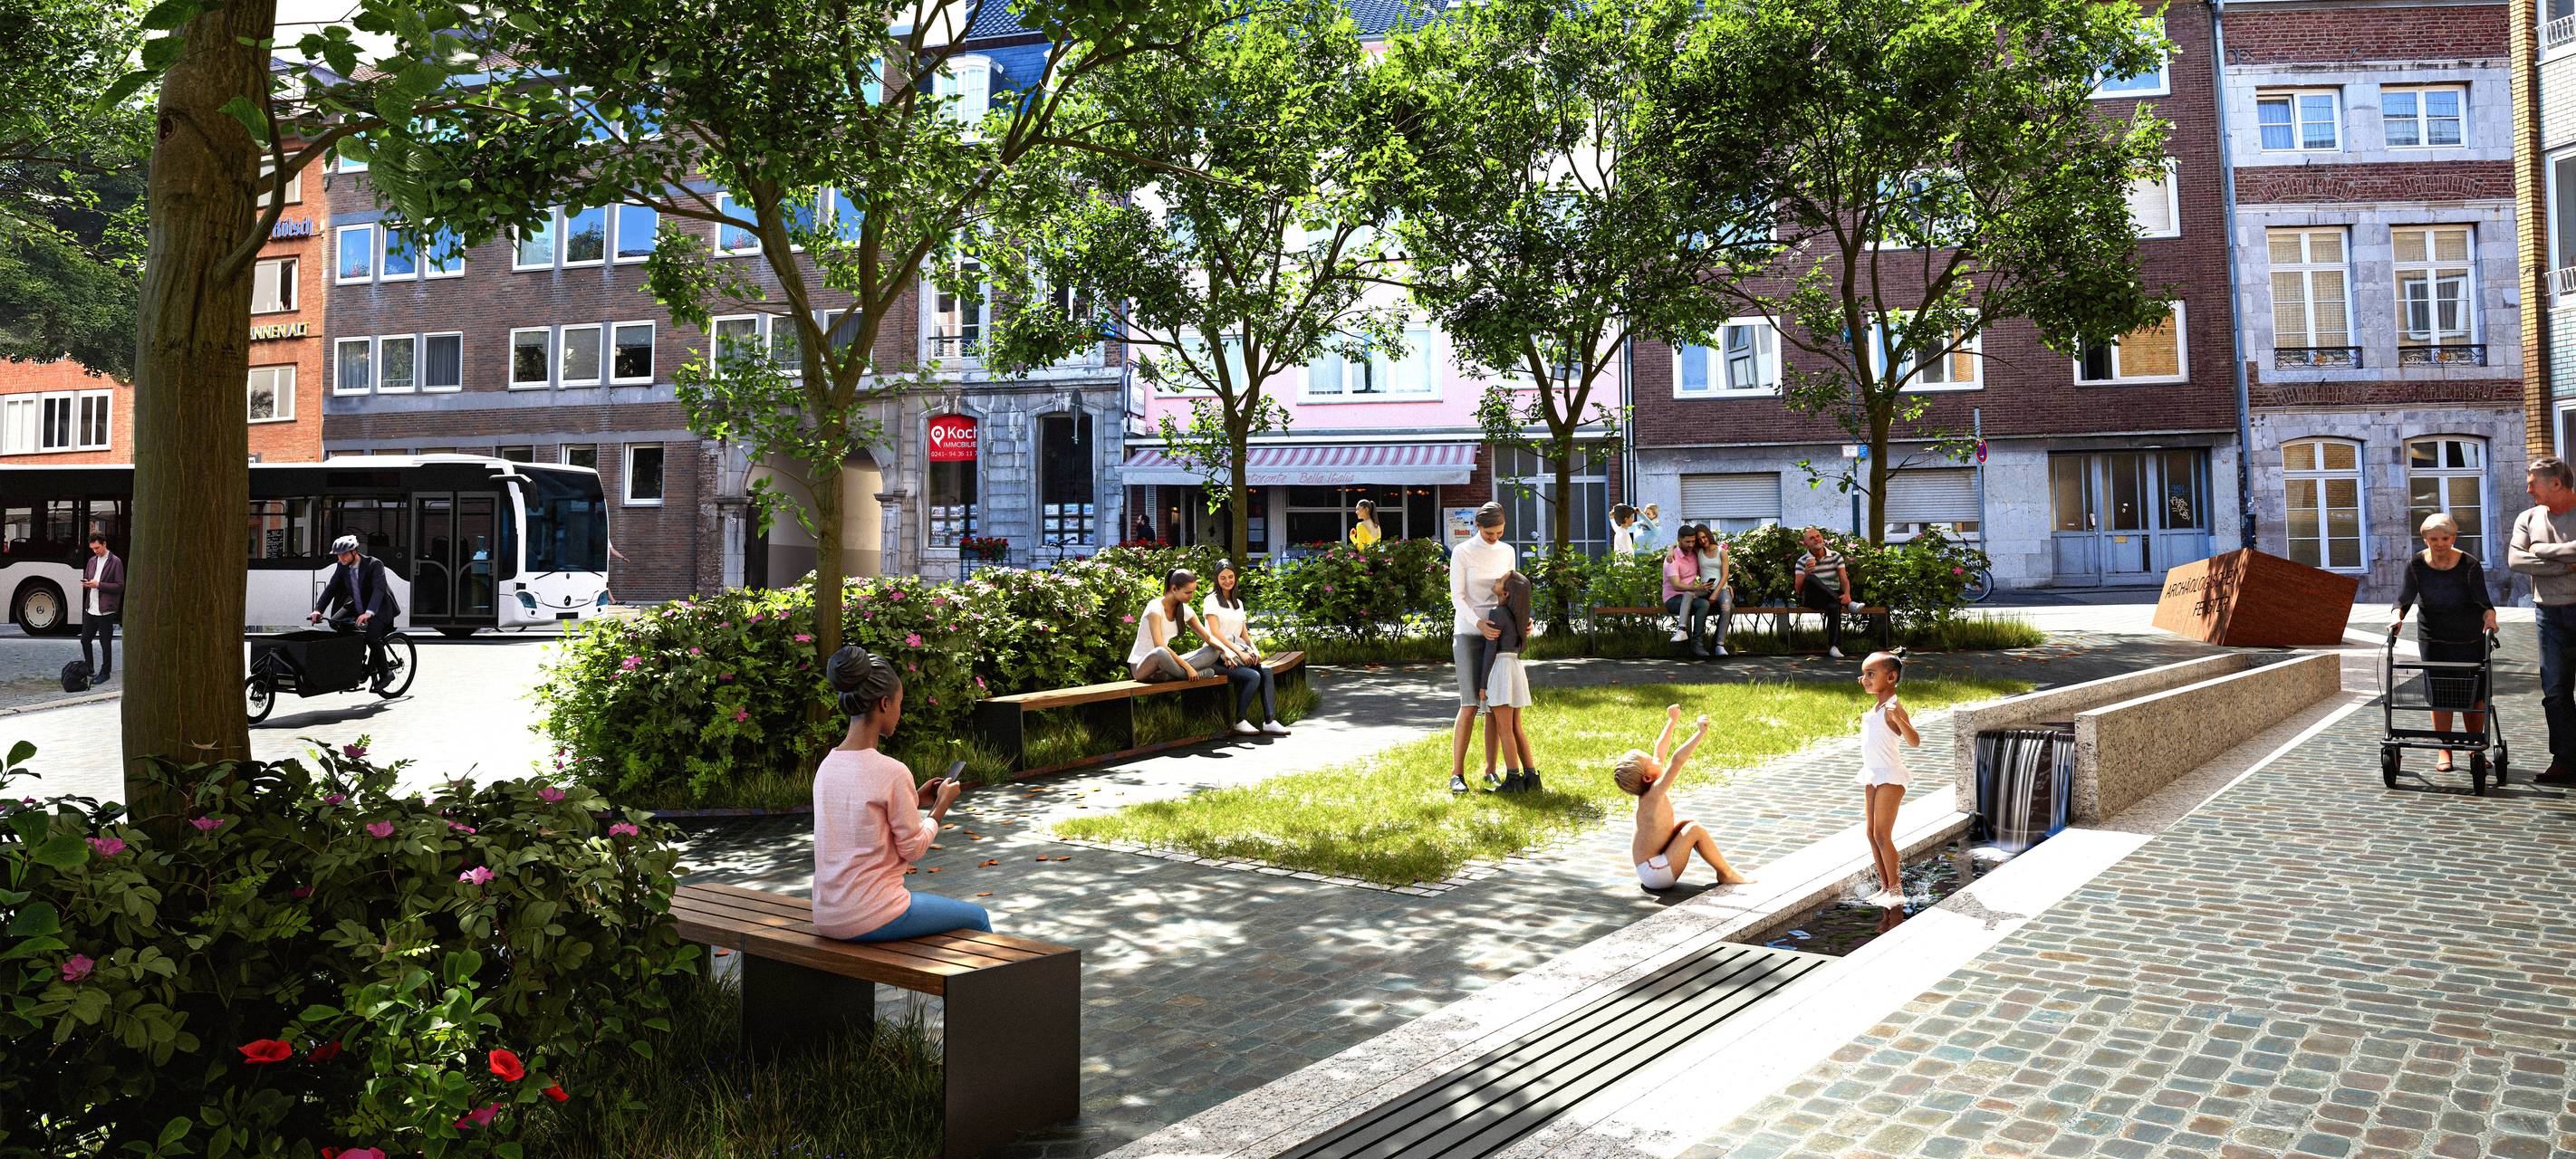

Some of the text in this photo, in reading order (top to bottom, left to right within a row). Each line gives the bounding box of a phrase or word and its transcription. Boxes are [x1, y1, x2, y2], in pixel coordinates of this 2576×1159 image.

[287, 321, 310, 336] ALT
[1299, 472, 1324, 484] Bella
[1326, 471, 1354, 484] Italia
